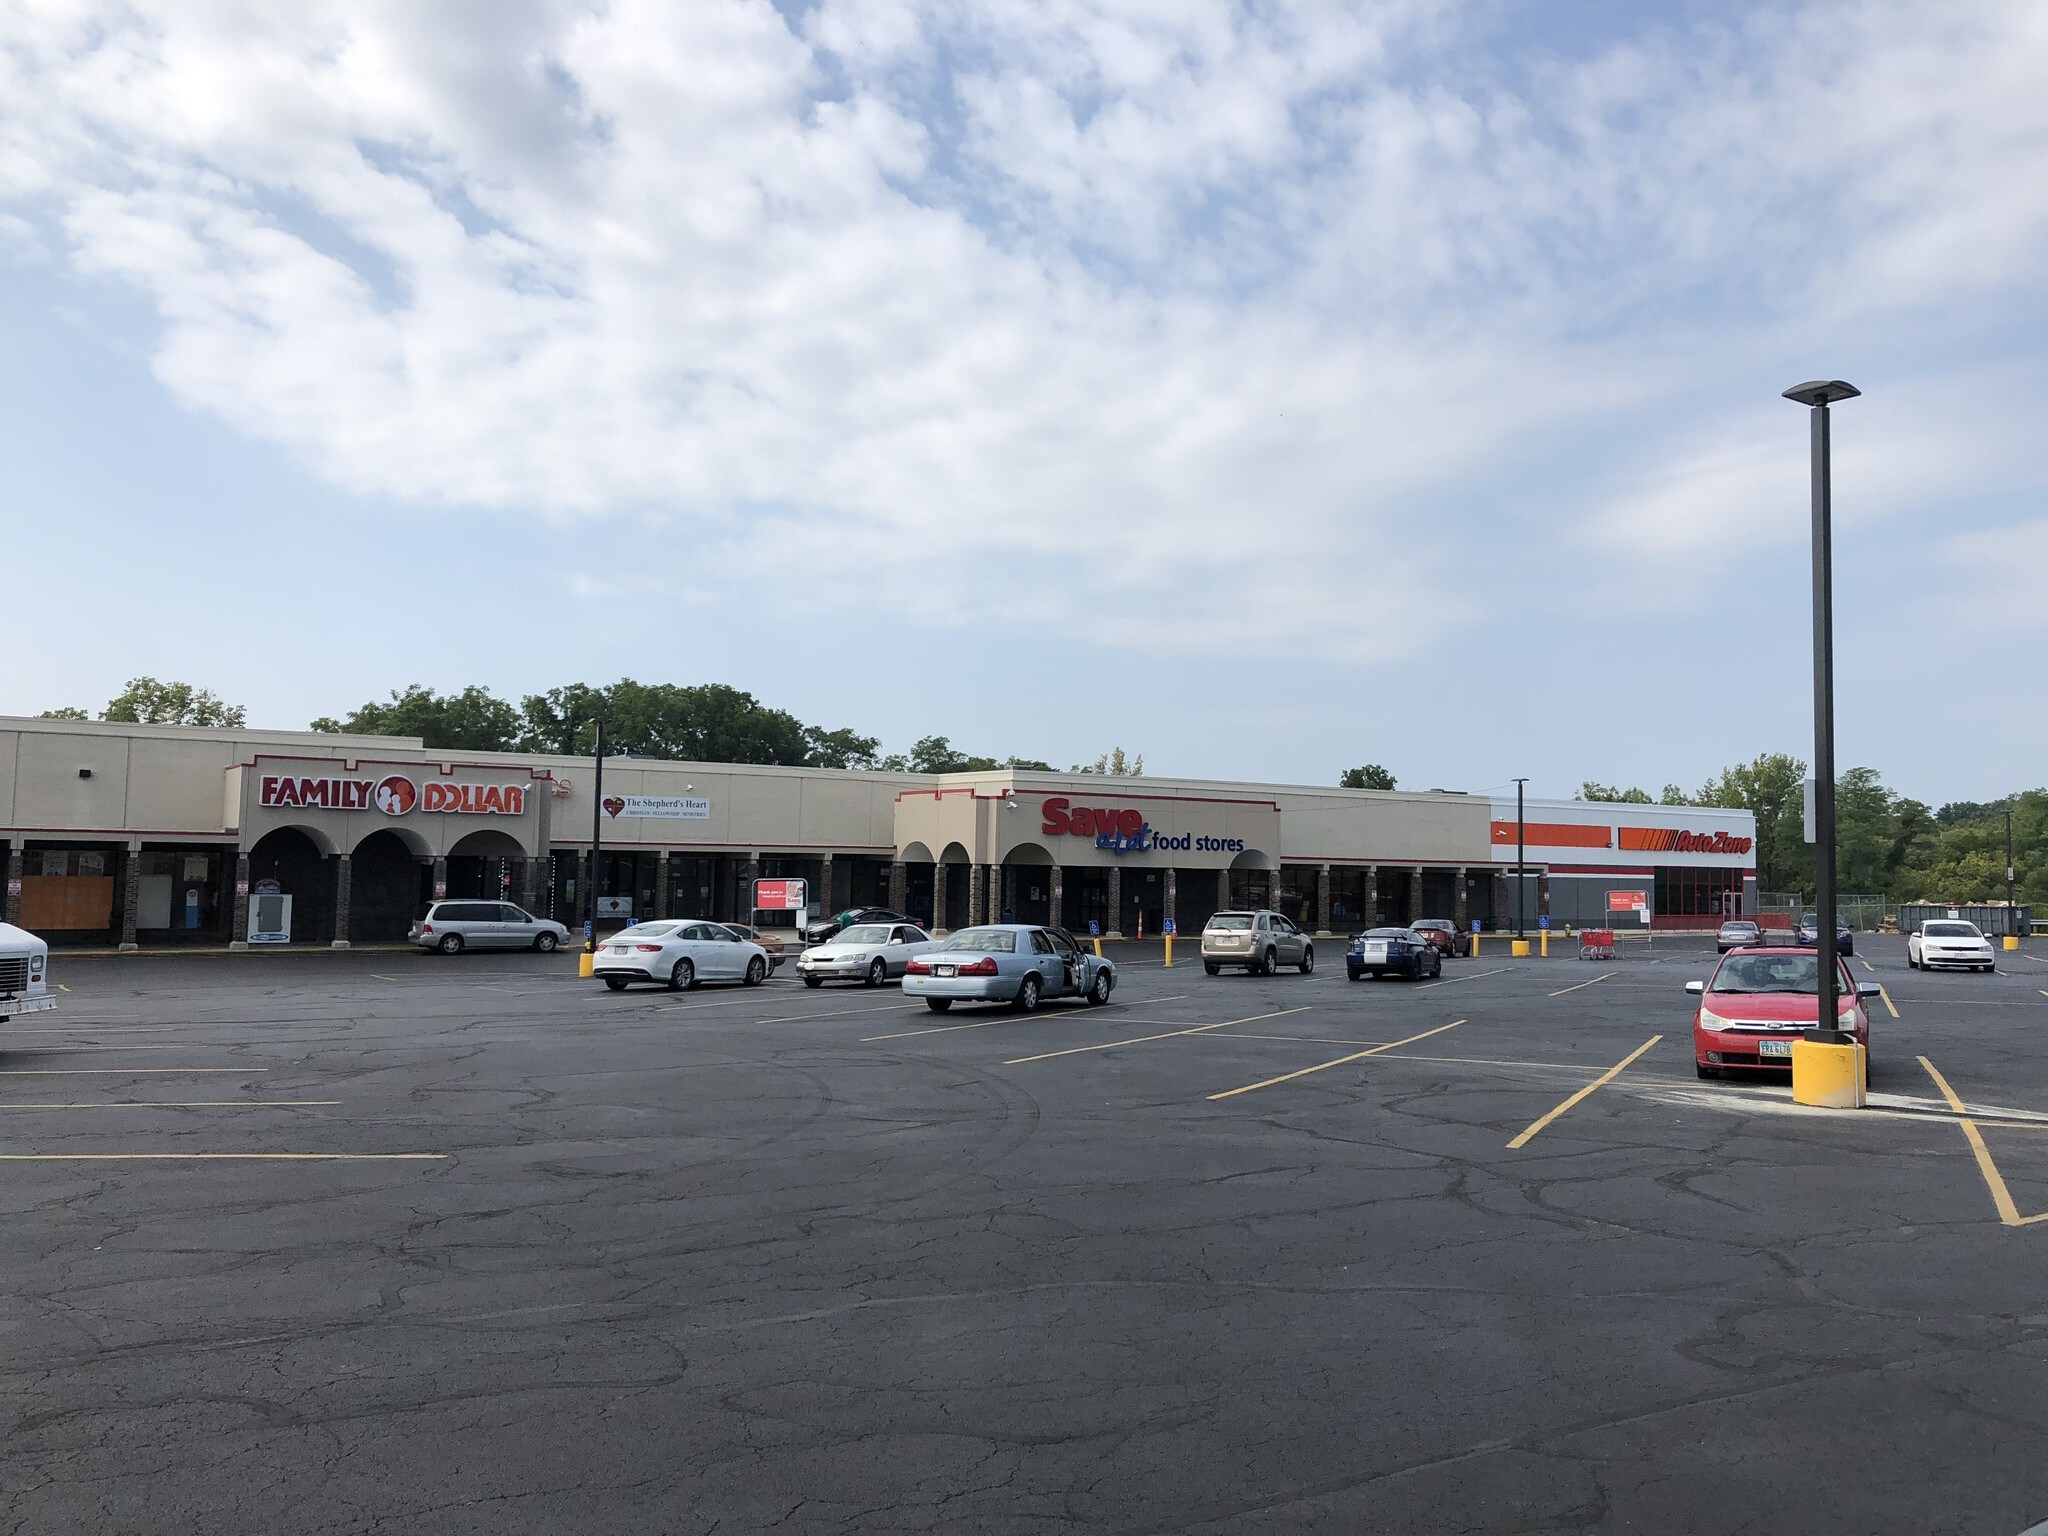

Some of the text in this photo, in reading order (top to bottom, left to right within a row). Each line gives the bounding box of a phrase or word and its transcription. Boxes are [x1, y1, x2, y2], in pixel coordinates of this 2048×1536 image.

[261, 775, 375, 809] FAMILY
[422, 781, 524, 814] DOLLAR
[627, 798, 707, 809] The Shepherd's Heart
[1041, 797, 1143, 836] Save
[1152, 831, 1244, 852] food stores
[1675, 829, 1752, 854] AutoZone
